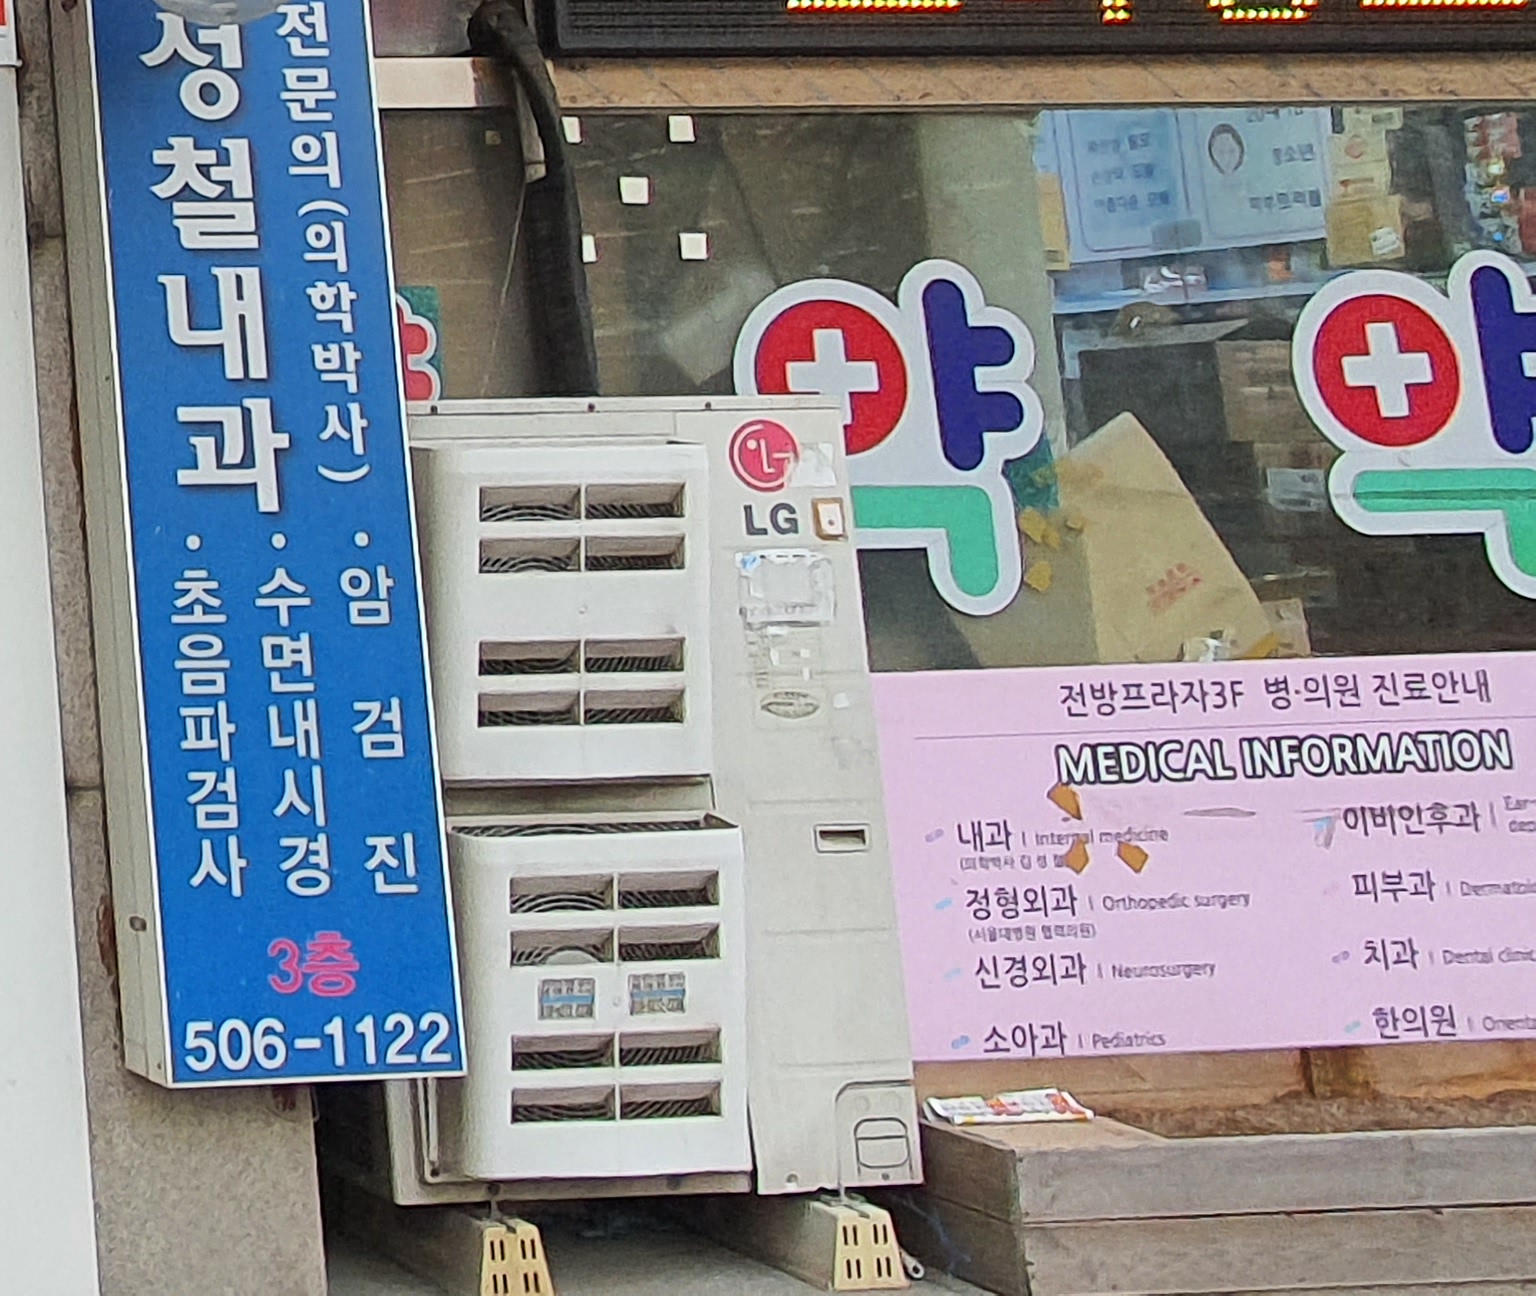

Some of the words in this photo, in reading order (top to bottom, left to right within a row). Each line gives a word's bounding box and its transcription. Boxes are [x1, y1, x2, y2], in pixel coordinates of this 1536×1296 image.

[743, 503, 800, 536] LG
[1059, 678, 1244, 718] 전방프라자3F
[1372, 668, 1492, 708] 진료안내
[170, 569, 250, 899] 초음파검사
[254, 566, 331, 897] 수면내시경
[1055, 737, 1236, 785] MEDICAL
[1240, 728, 1514, 780] INFORMATION
[957, 820, 1013, 853] 내과
[1343, 801, 1481, 837] 이비인후과
[966, 885, 1078, 921] 정형외과
[1352, 870, 1436, 904] 피부과
[268, 931, 360, 998] 3층
[975, 952, 1087, 990] 신경외과
[1364, 937, 1419, 971] 치과
[983, 1021, 1068, 1057] 소아과
[1372, 1004, 1458, 1040] 한의원
[184, 1012, 452, 1072] 506-1122
